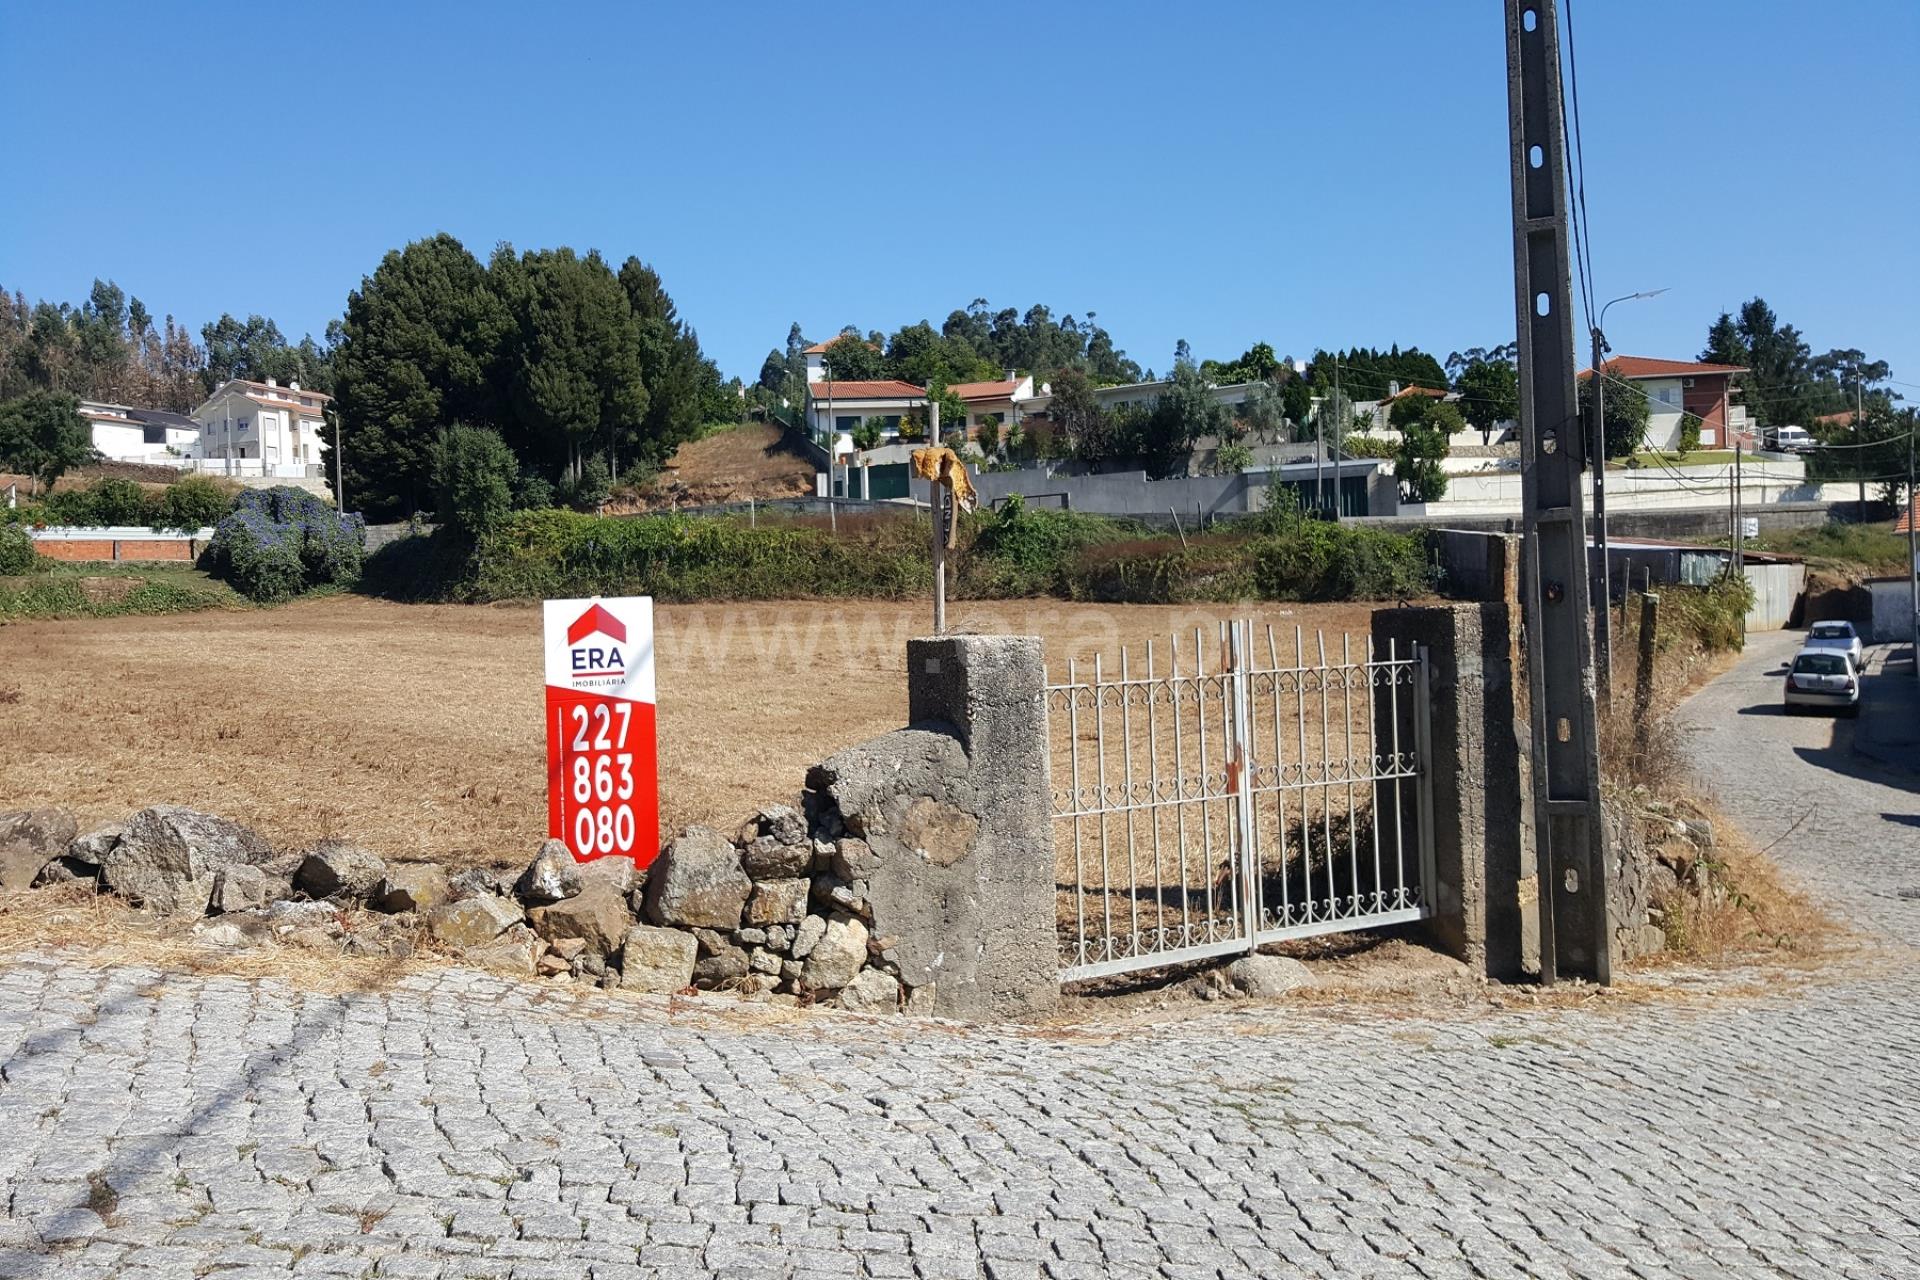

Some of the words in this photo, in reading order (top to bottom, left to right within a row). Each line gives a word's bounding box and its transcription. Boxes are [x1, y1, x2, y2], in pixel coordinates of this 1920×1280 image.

[571, 647, 625, 670] ERA
[572, 678, 626, 688] IMOBILIÁRIA
[572, 702, 632, 752] 227
[573, 753, 634, 804] 863
[575, 803, 635, 855] 080
